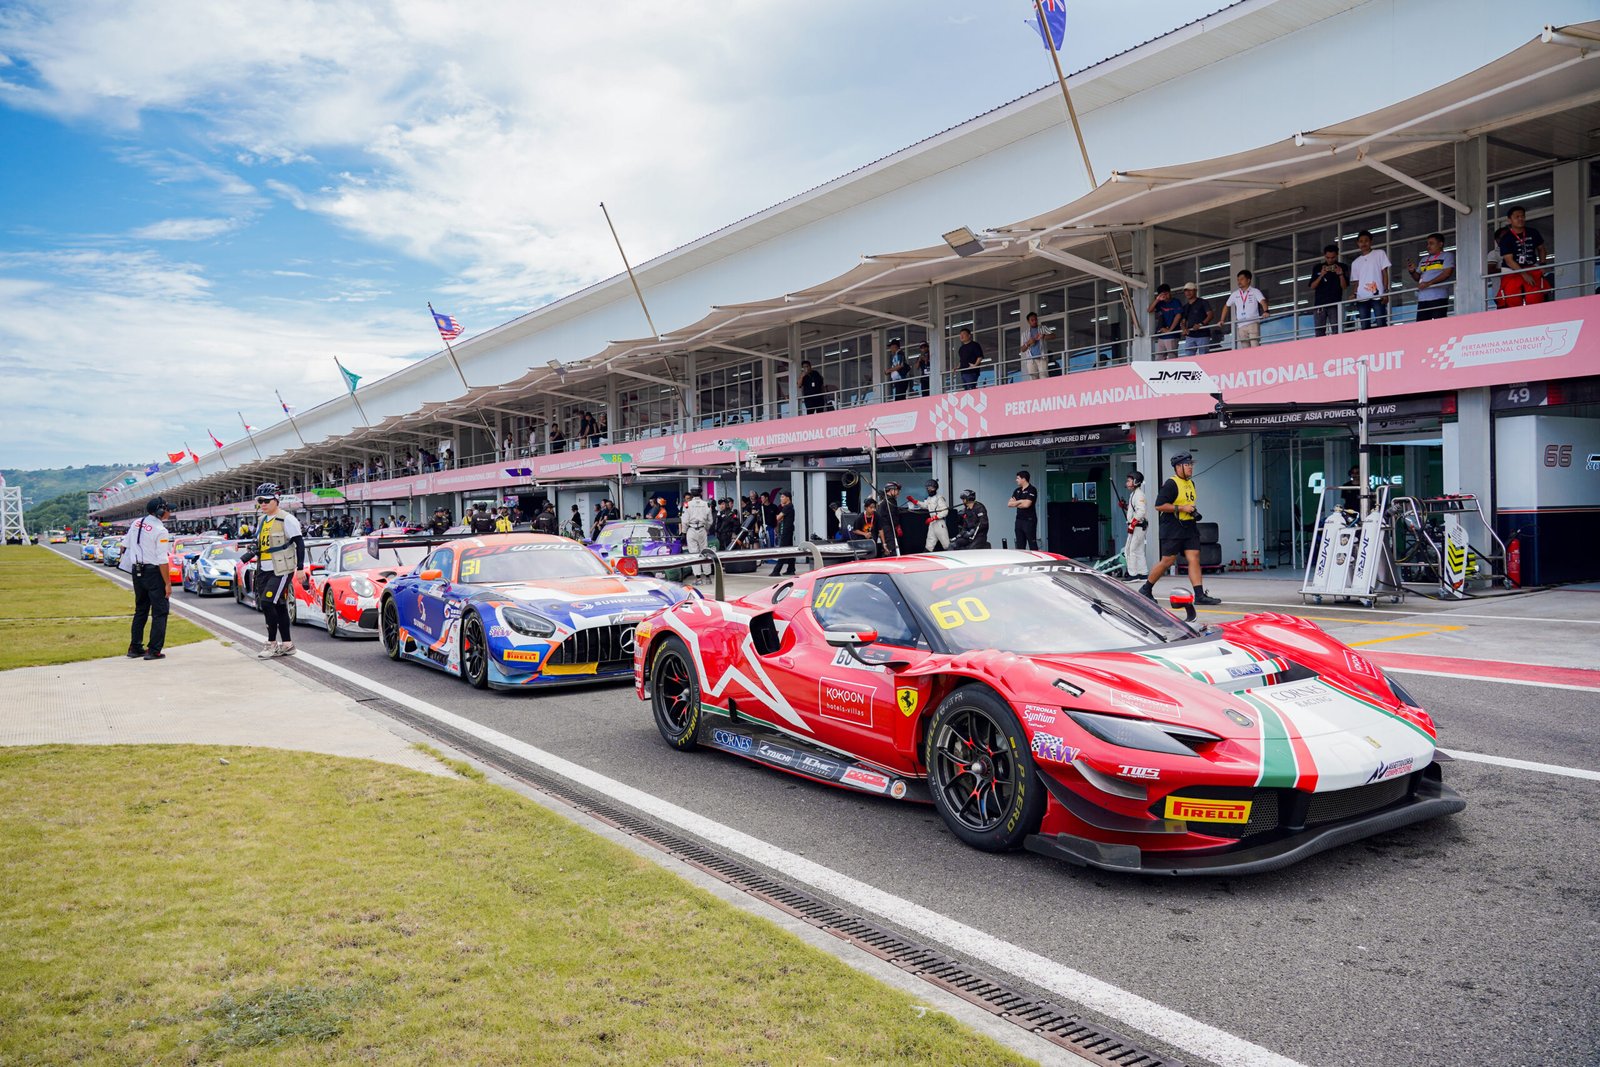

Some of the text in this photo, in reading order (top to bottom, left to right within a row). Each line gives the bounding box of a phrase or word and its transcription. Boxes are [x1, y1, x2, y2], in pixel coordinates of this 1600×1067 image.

[1461, 335, 1546, 351] PERTAMINA MANDALIKA
[1461, 342, 1543, 358] INTERNATIONAL CIRCUIT
[1149, 371, 1192, 380] JMR
[1005, 396, 1077, 416] PERTAMINA
[1079, 383, 1172, 407] MANDALI
[1507, 388, 1530, 403] 49
[1260, 413, 1302, 424] CHALLENGE
[1304, 412, 1323, 421] ASIA
[1377, 405, 1396, 414] AWS
[766, 428, 824, 445] INTERNATIONAL
[826, 424, 856, 437] CIRCUIT
[1167, 422, 1181, 433] 48
[954, 443, 963, 452] 47
[1013, 439, 1041, 447] CHALLENGE
[611, 454, 622, 462] 86
[1544, 445, 1572, 468] 66
[626, 545, 639, 556] 86
[461, 560, 480, 576] 31
[814, 583, 845, 608] 60
[929, 597, 991, 630] 60
[507, 651, 537, 660] PIRELLI
[826, 687, 865, 704] KOKOON
[1270, 684, 1327, 702] CORNES
[1025, 704, 1057, 715] PETRONAS
[1295, 697, 1331, 707] RACING
[1022, 710, 1055, 725] Syntium
[714, 731, 751, 750] CORNES
[1039, 741, 1080, 765] KW
[1118, 764, 1160, 777] TWS
[1007, 763, 1025, 832] P ZERO
[1172, 801, 1246, 820] PIRELLI
